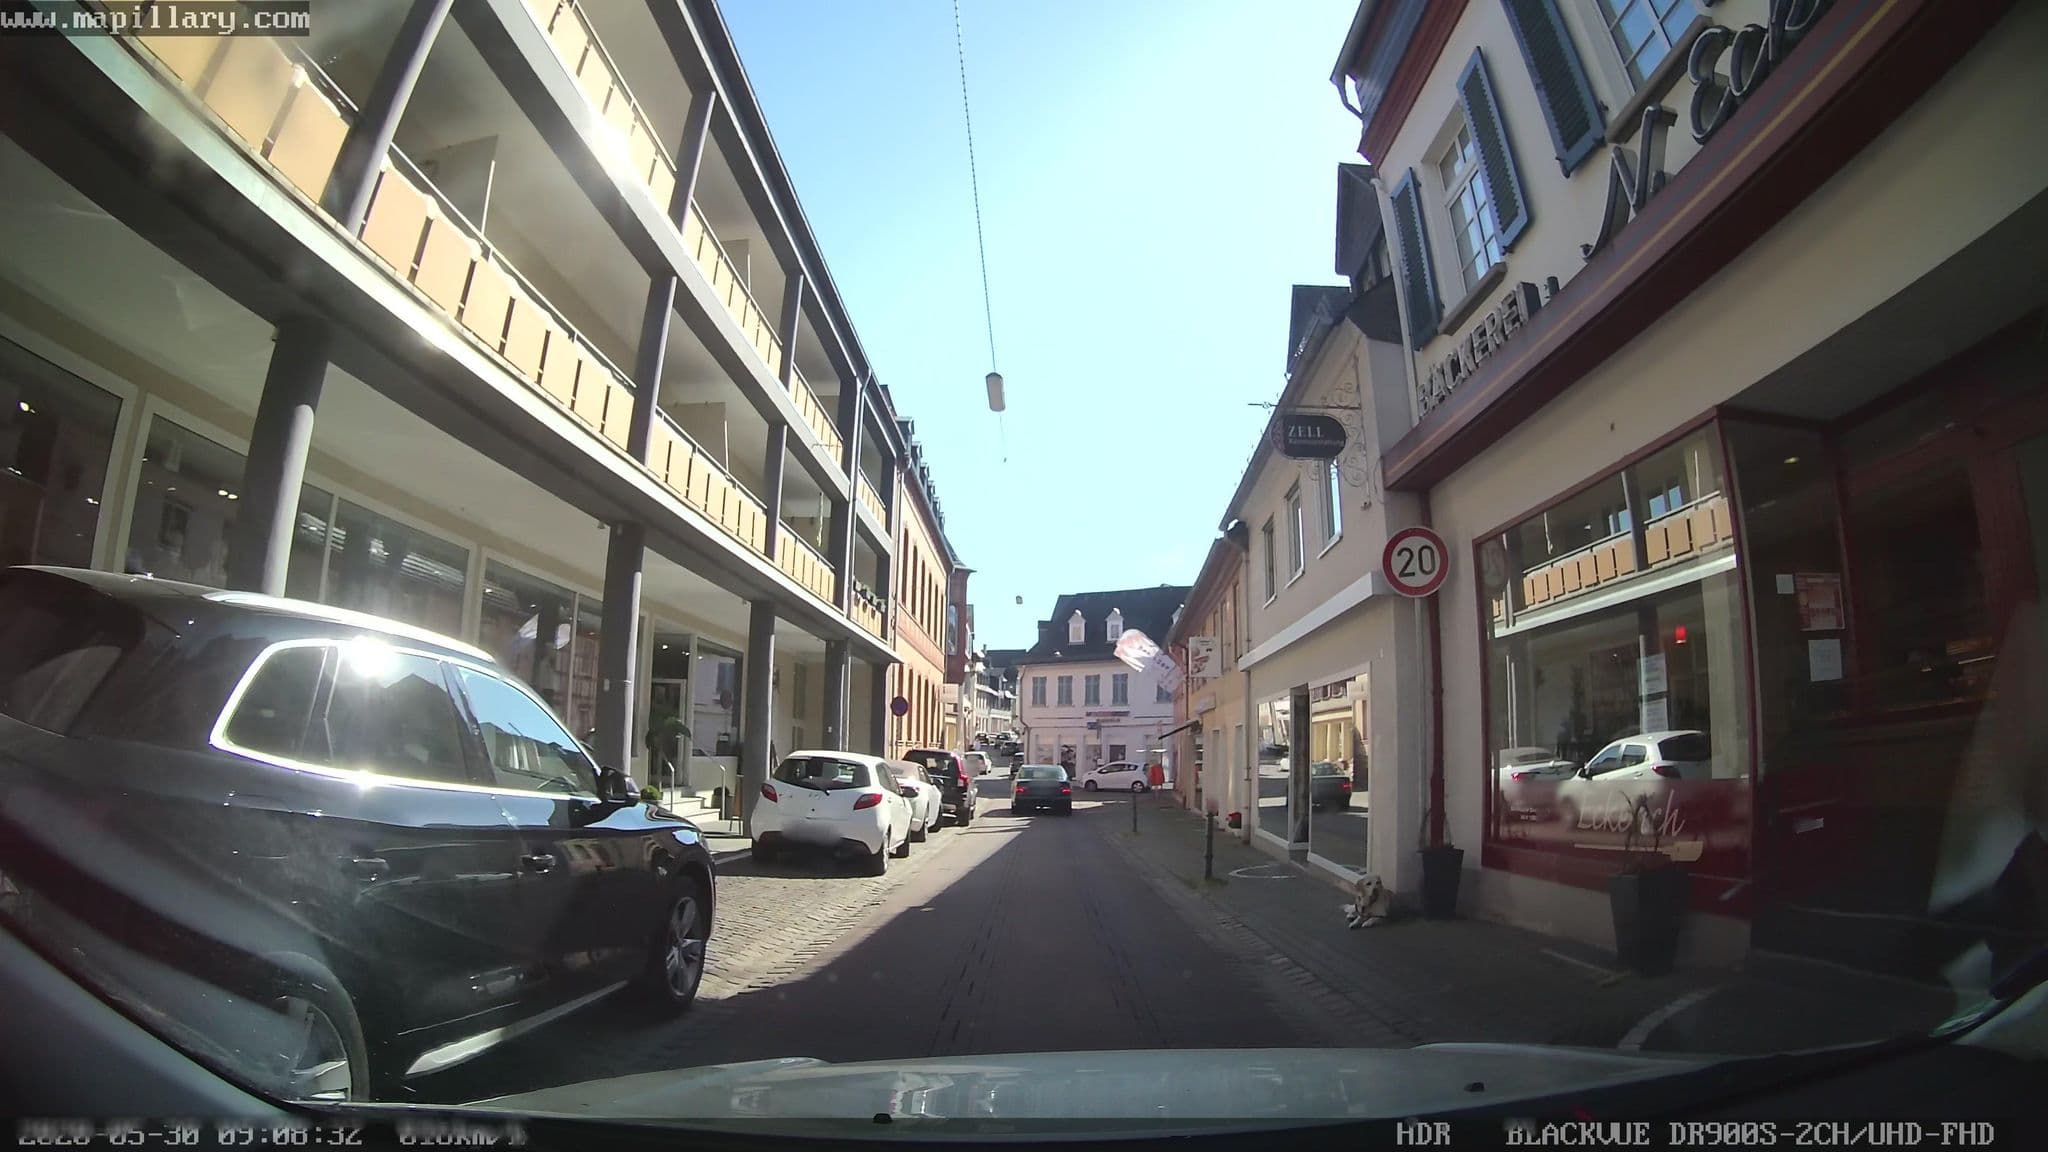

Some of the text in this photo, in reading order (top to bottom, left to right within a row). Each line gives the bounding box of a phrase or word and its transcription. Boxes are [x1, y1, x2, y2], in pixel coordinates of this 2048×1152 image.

[1417, 281, 1541, 419] BÄCKEREI
[1288, 424, 1325, 439] ZELL
[1396, 544, 1437, 578] 20
